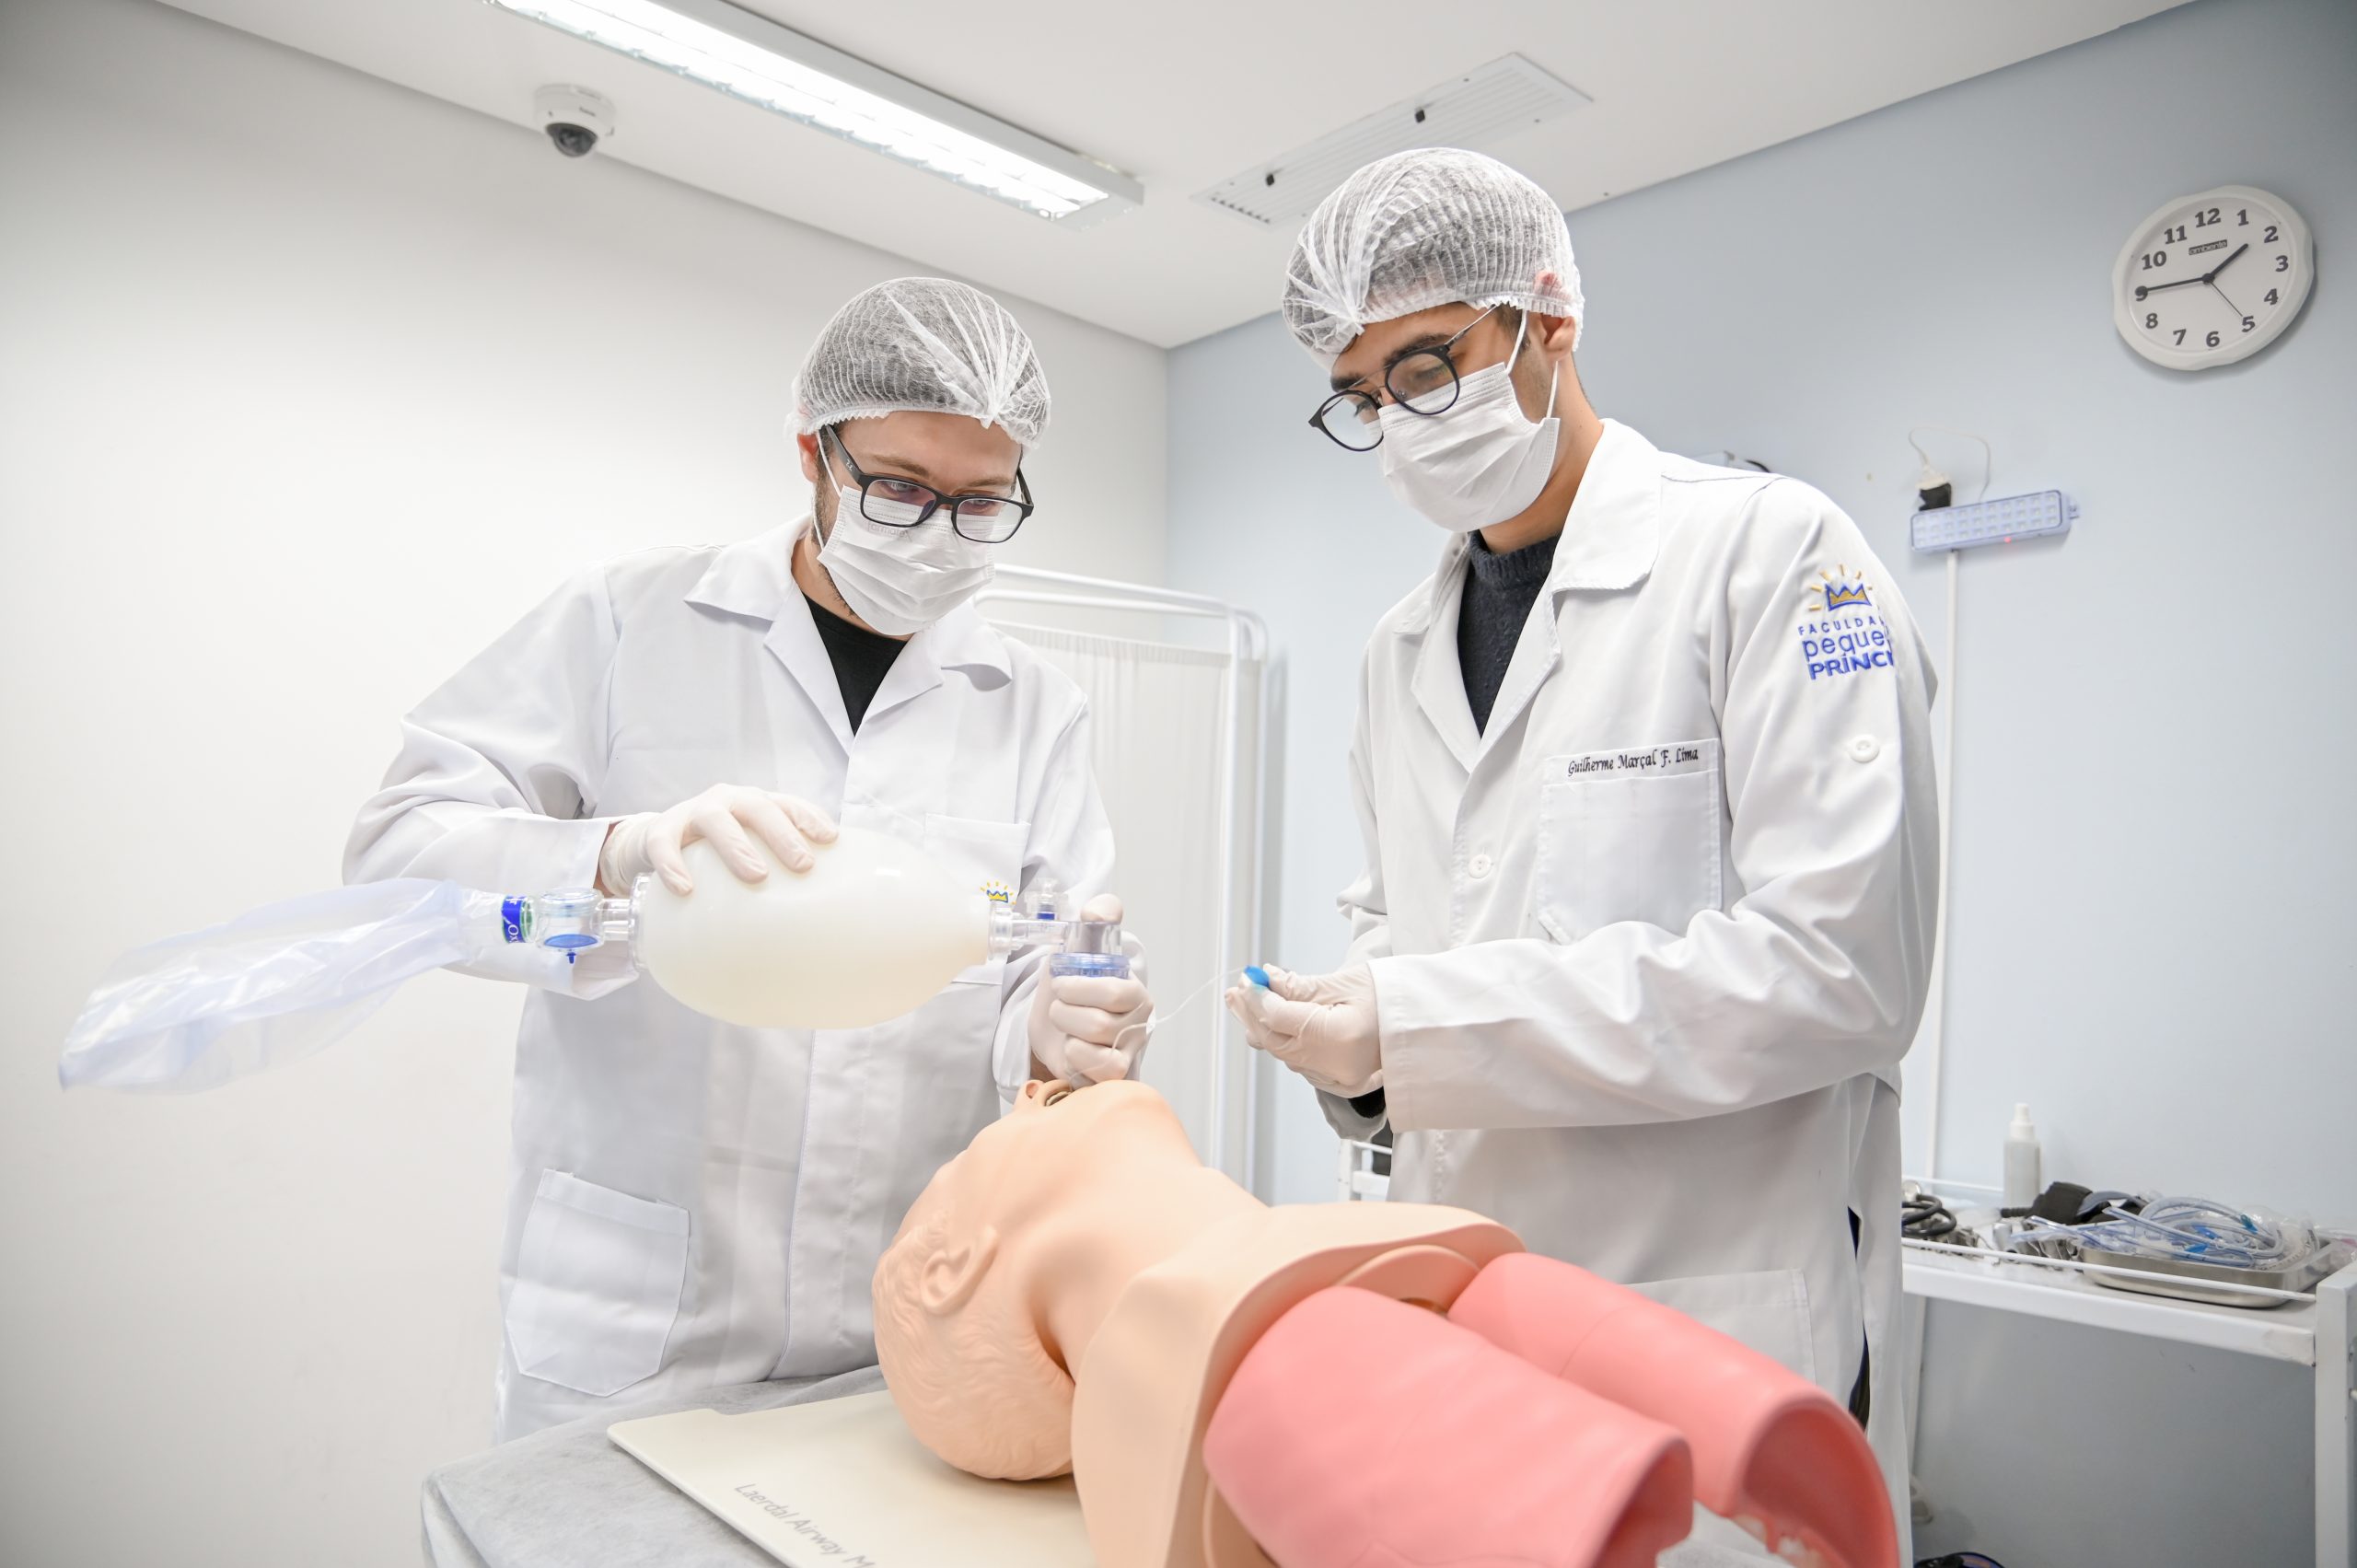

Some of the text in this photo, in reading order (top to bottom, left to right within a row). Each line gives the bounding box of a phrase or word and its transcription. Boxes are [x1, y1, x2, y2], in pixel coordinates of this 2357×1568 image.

[2194, 207, 2222, 228] 12
[2236, 209, 2249, 226] 1
[2164, 225, 2188, 245] 11
[2263, 226, 2279, 243] 2
[2142, 250, 2167, 270] 10
[2275, 255, 2289, 273] 3
[2134, 285, 2148, 302] 9
[2263, 288, 2279, 306] 4
[2145, 312, 2159, 330] 8
[2240, 315, 2256, 332] 5
[2172, 329, 2187, 346] 7
[2205, 331, 2220, 348] 6
[1797, 615, 1884, 636] FACULDA
[1802, 630, 1888, 662] peque
[1568, 747, 1699, 777] Guilherme Marçal F. Lima
[734, 1483, 800, 1519] Laerdal
[784, 1519, 848, 1555] Airway
